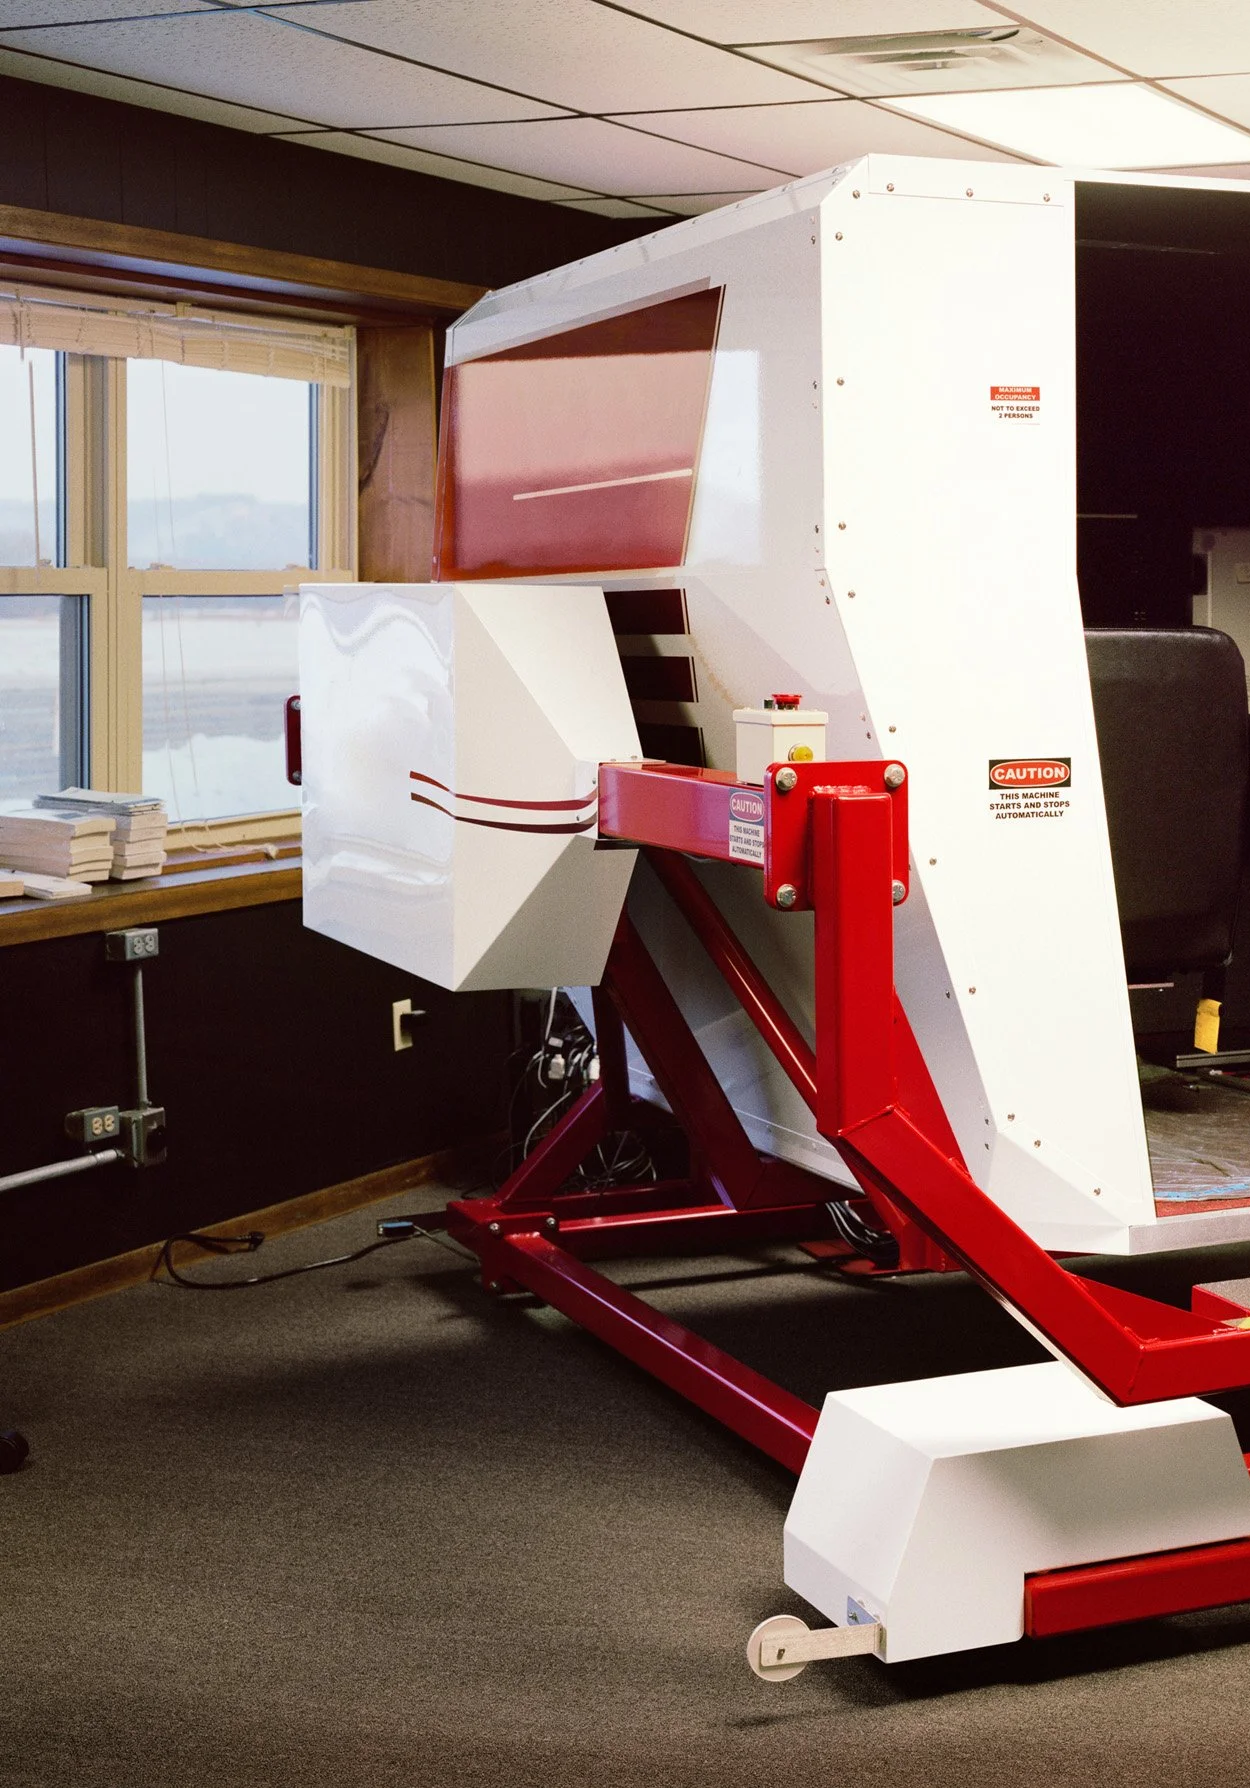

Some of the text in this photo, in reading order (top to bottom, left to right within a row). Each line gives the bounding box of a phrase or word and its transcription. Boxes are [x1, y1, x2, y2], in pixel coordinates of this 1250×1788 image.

[994, 766, 1065, 780] CAUTION
[1000, 791, 1060, 800] THIS MACHINE
[731, 798, 763, 815] CAUTION
[989, 802, 1022, 811] STARTS
[1043, 800, 1070, 809] STOPS
[995, 810, 1064, 820] AUTOMATICALLY
